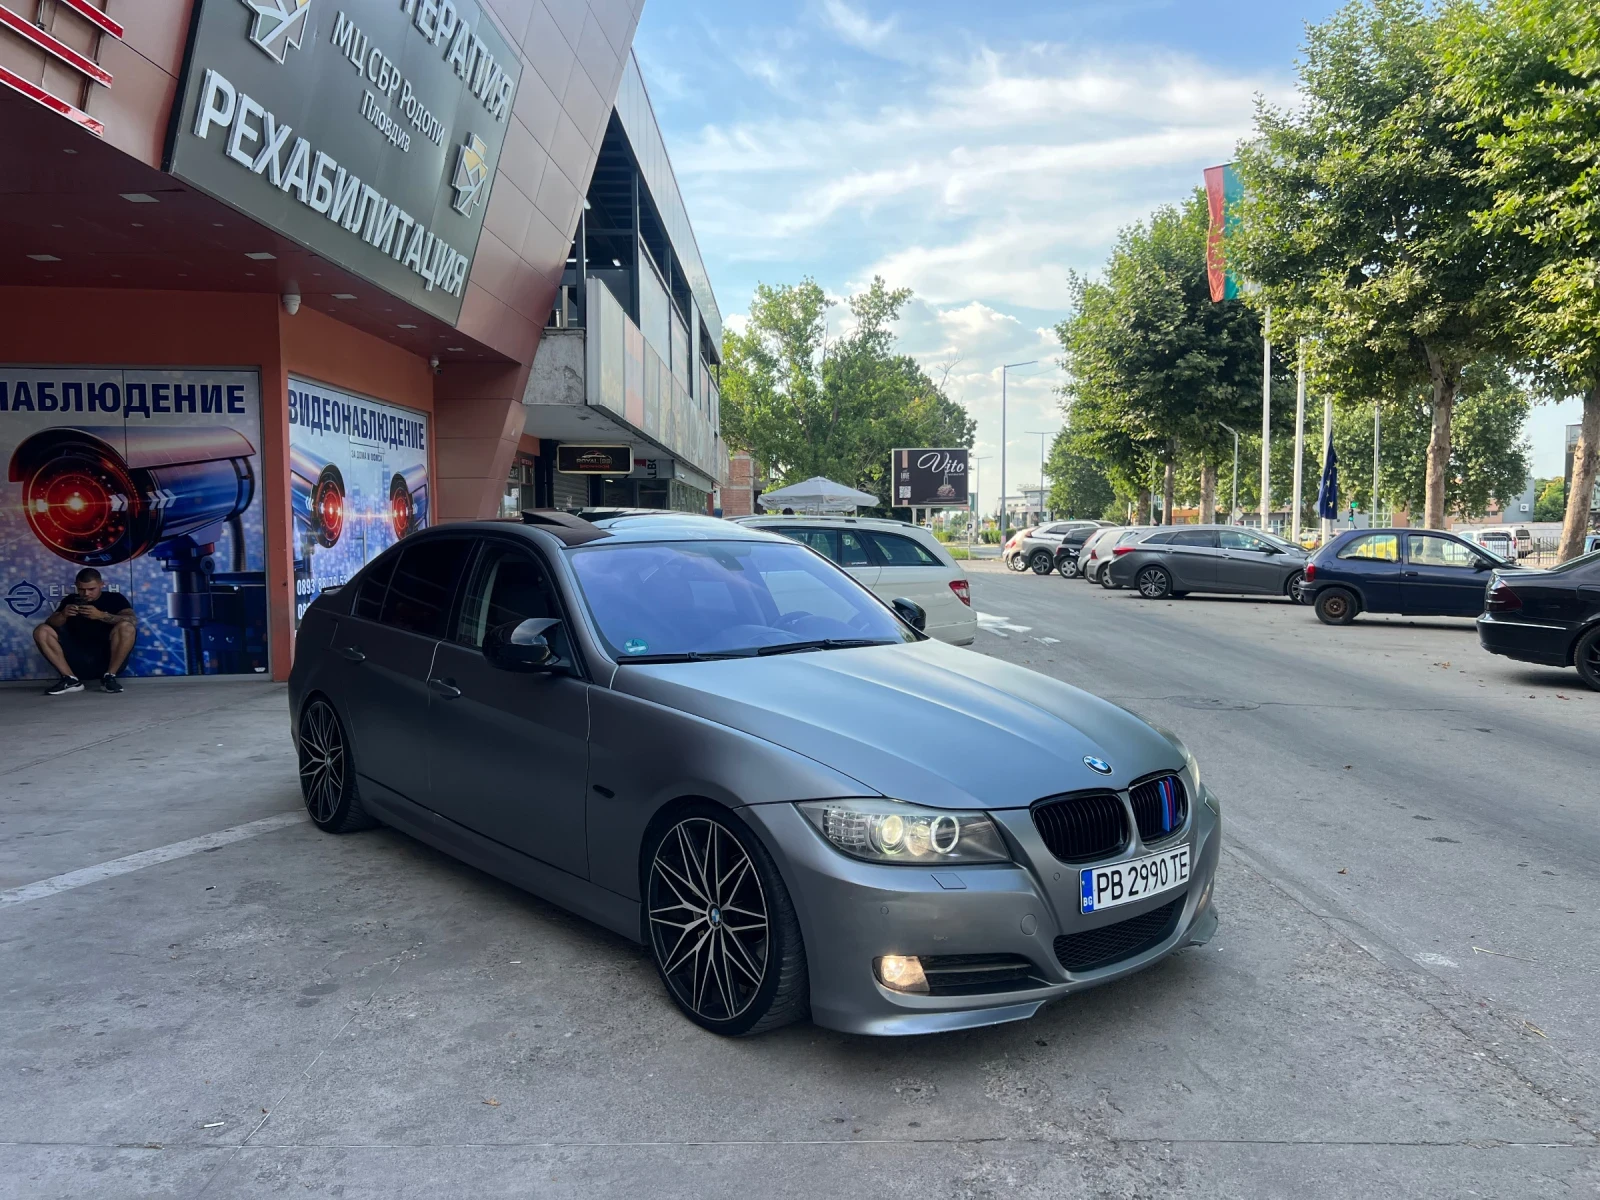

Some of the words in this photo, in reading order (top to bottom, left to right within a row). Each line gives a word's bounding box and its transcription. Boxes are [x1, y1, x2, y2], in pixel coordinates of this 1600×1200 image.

[331, 11, 367, 76] МЦ
[367, 47, 401, 97] СБР
[194, 69, 468, 297] РЕХАБИЛИТАЦИЯ
[288, 389, 425, 451] ВИДЕОНАБЛЮДЕНИЕ
[917, 452, 965, 473] Vito
[296, 578, 316, 596] 0893
[1083, 896, 1093, 907] BG
[1096, 870, 1124, 904] PB
[1128, 858, 1168, 897] 2990
[1170, 851, 1188, 882] TE
